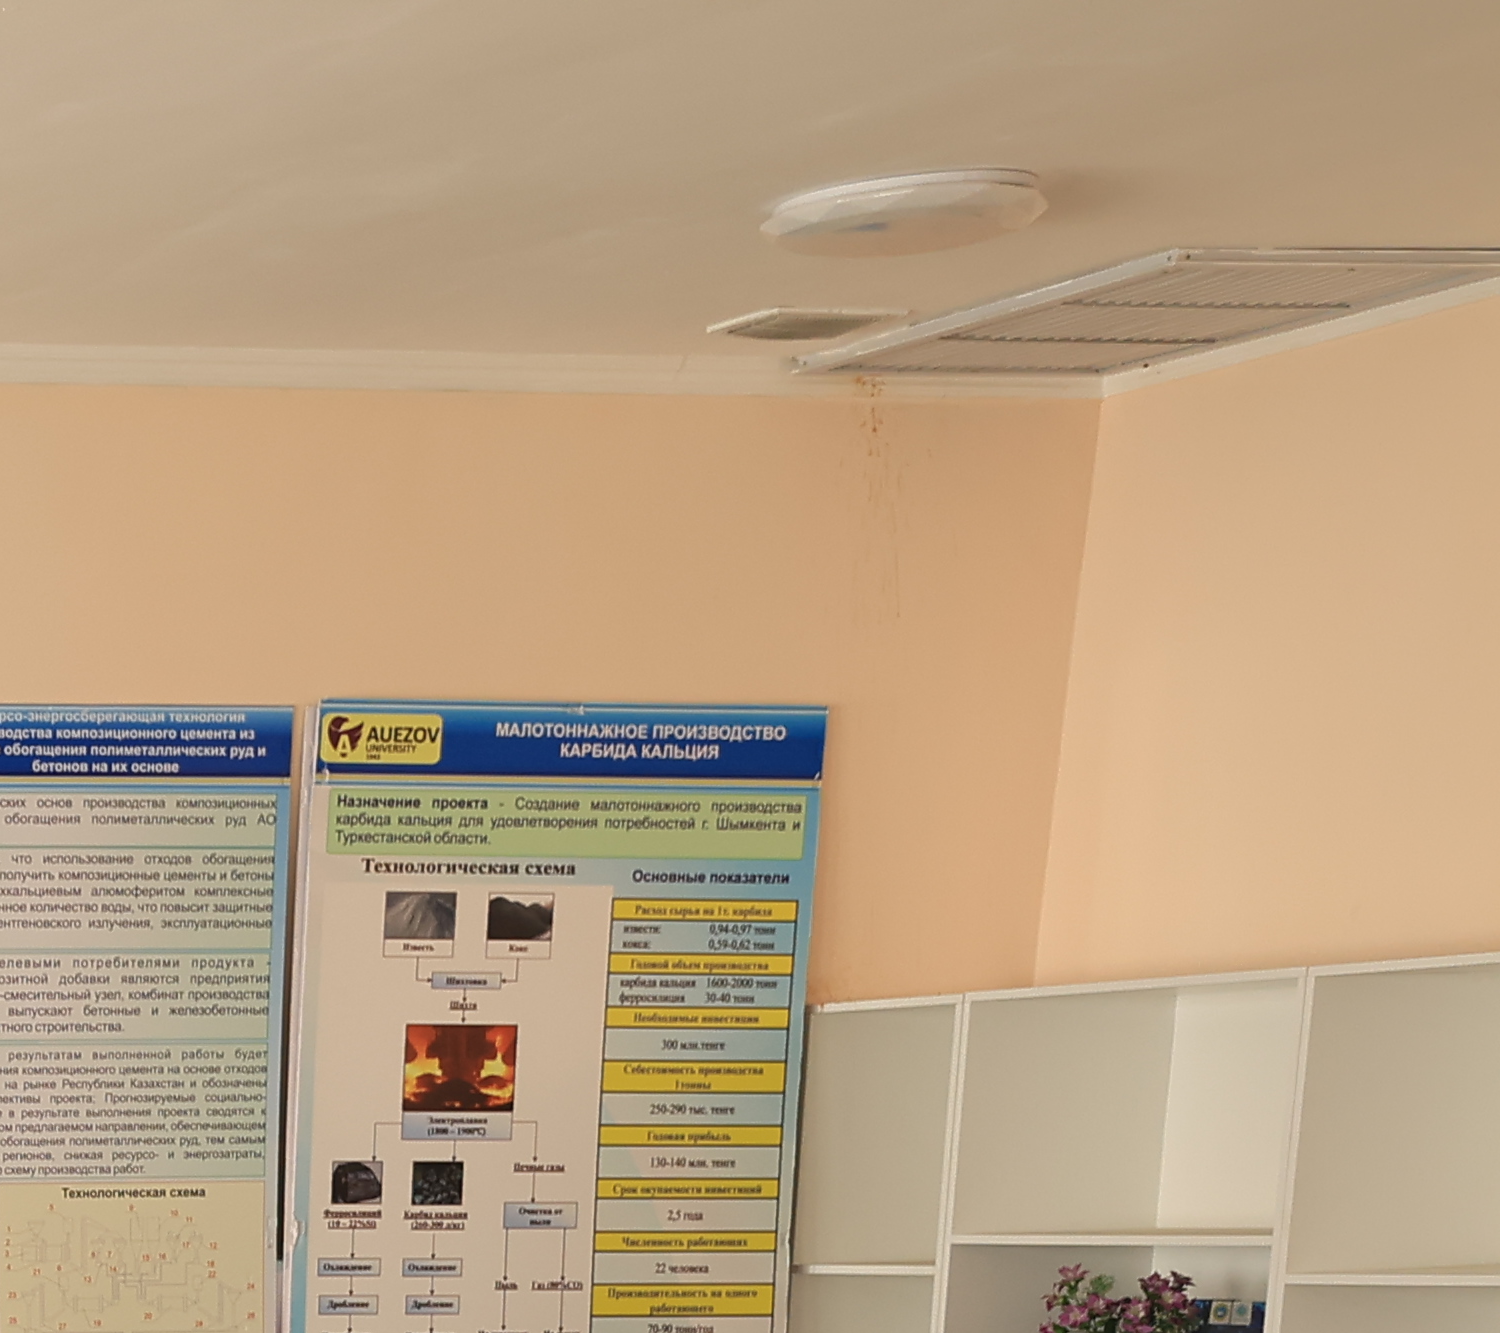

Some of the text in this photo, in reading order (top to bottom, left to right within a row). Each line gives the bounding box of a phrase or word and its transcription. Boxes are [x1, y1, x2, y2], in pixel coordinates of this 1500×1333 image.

[55, 729, 177, 740] композиционного
[180, 729, 236, 740] цемента
[239, 729, 254, 740] из
[366, 726, 440, 744] AUEZOV
[494, 722, 788, 742] МАЛОТОННАЖНОЕ ПРОИЗВОДСТВО
[3, 742, 87, 757] обогащения
[90, 746, 226, 756] полиметаллических
[229, 746, 254, 760] руд
[257, 747, 266, 756] и
[366, 744, 418, 754] UNIVERSITY
[560, 743, 719, 760] КАРБИДА КАЛЬЦИЯ
[31, 759, 179, 773] бетонов на их основе
[36, 798, 73, 808] основ
[82, 799, 166, 810] производства
[175, 798, 278, 810] композиционных
[336, 794, 421, 808] Назначение
[431, 799, 488, 811] проекта
[514, 796, 580, 812] Создание
[590, 801, 700, 812] малотоннажного
[710, 802, 802, 815] производства
[4, 812, 80, 826] обогащения
[91, 816, 214, 825] полиметаллических
[224, 816, 246, 828] руд
[256, 812, 278, 826] АО
[334, 829, 490, 846] Туркестанской области.
[360, 858, 576, 876] Технологическая схема
[632, 870, 789, 884] Основные показатели
[62, 1187, 206, 1198] Технологическая схема
